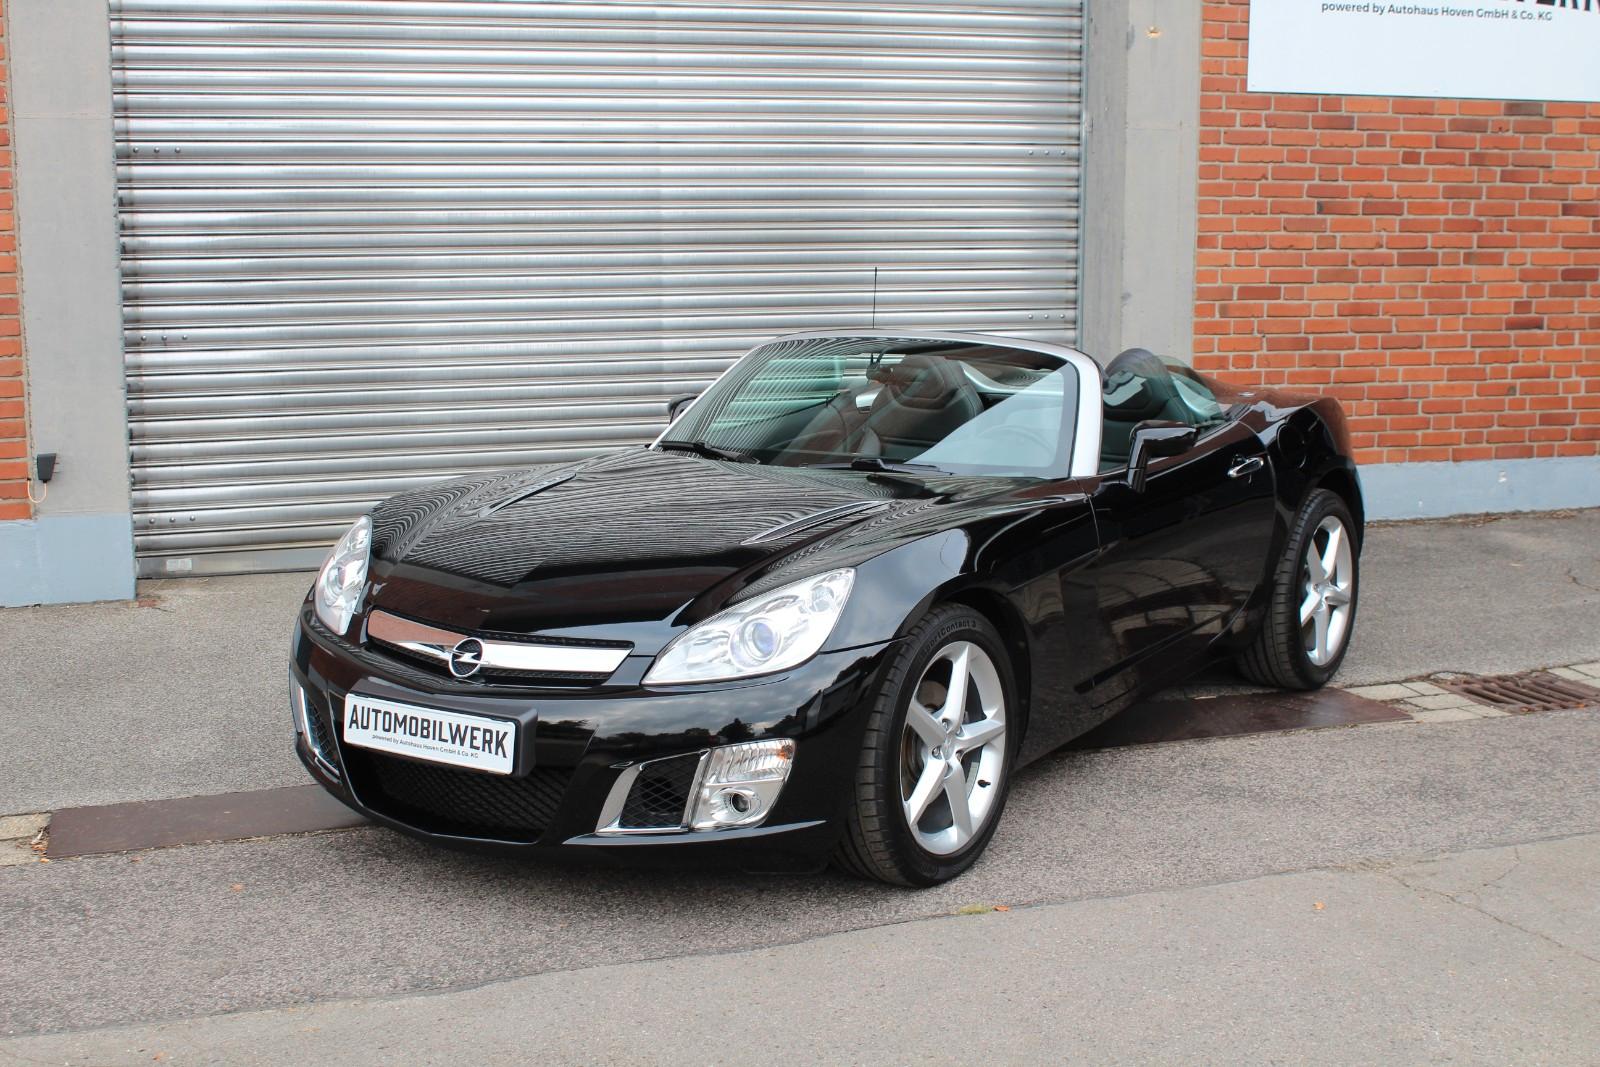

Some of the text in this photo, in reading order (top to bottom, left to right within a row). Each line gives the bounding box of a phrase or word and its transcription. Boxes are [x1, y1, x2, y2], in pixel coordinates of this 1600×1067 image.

[1322, 2, 1553, 21] powered by Autohaus Hoven GmbH & Co. KG
[348, 704, 508, 758] AUTOMOBILWERK
